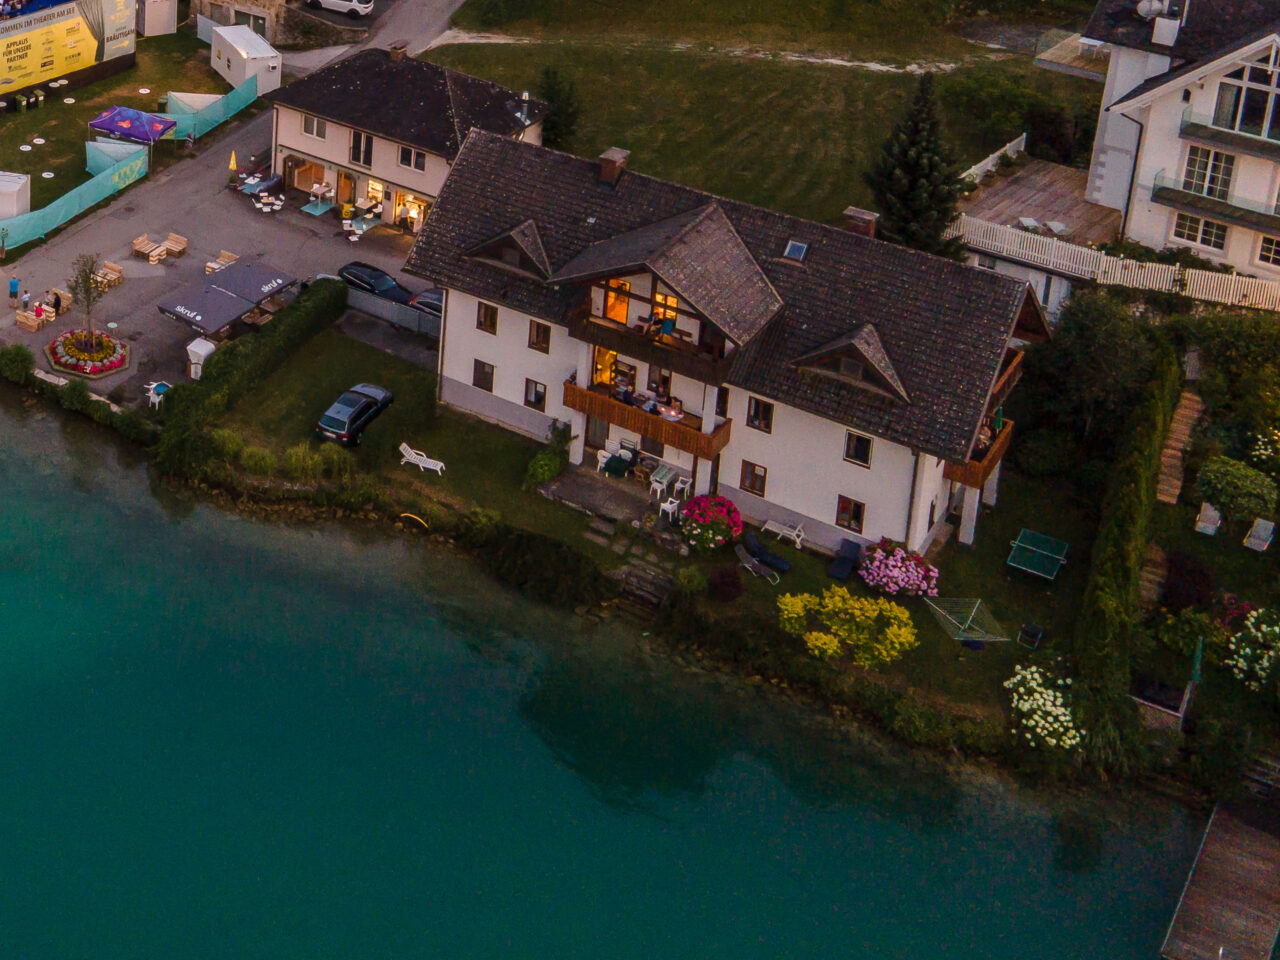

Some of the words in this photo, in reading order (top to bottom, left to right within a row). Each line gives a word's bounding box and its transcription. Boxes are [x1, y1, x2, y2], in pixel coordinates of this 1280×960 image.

[24, 19, 33, 28] IM
[34, 12, 56, 25] THEATER
[57, 9, 66, 18] AM
[6, 37, 29, 49] APPLAUS
[2, 49, 13, 58] FÜR
[13, 43, 32, 55] UNSERE
[6, 52, 28, 64] PARTNER
[261, 280, 276, 293] skruf
[175, 304, 197, 319] skruf
